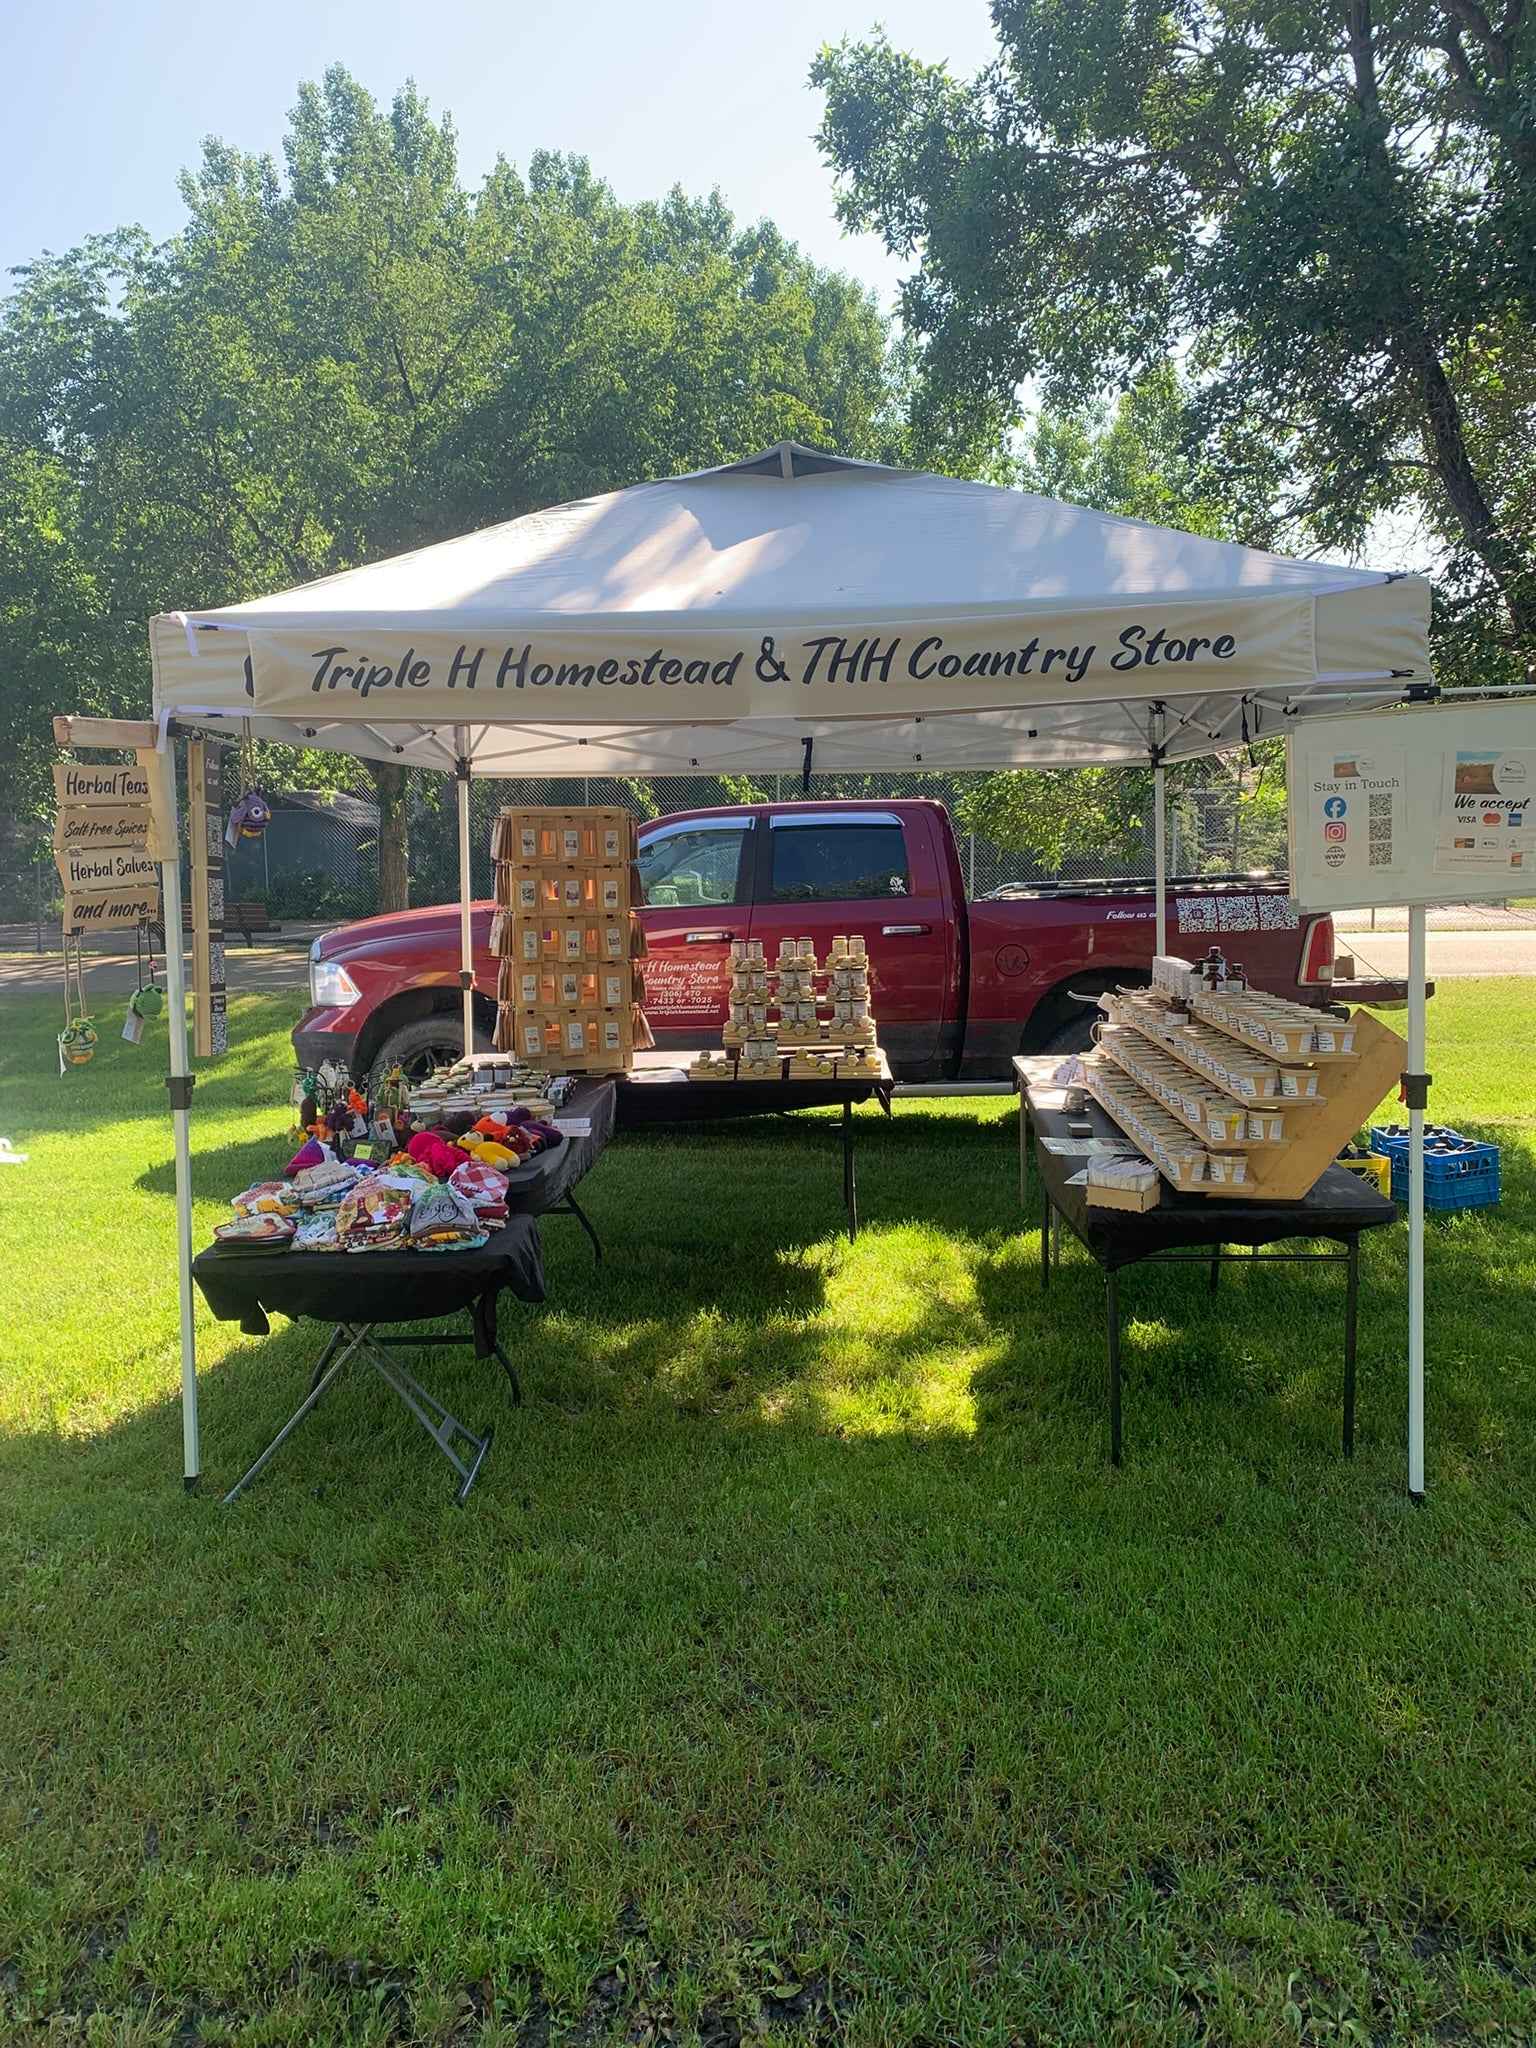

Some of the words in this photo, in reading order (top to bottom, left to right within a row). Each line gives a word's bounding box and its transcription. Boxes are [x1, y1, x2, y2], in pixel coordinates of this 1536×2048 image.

[311, 647, 431, 697] Triple
[447, 645, 485, 688] H
[496, 644, 744, 688] Homestead
[755, 636, 791, 682] &
[801, 636, 901, 684] THH
[907, 636, 1096, 683] Country
[1109, 624, 1236, 671] Store
[66, 771, 117, 796] Herbal
[119, 771, 149, 796] Teas
[1313, 782, 1341, 793] Stay
[1345, 780, 1357, 790] in
[1360, 777, 1400, 789] Touch
[1454, 794, 1476, 809] We
[1479, 797, 1531, 812] accept
[114, 819, 148, 838] Spices
[1457, 815, 1478, 824] VISA
[70, 861, 113, 881] Herbal
[116, 857, 154, 877] Salves
[73, 899, 106, 920] and
[108, 903, 157, 919] more...
[1106, 910, 1135, 920] Follow
[647, 960, 658, 972] H
[659, 960, 721, 972] Homestead
[643, 974, 685, 985] Country
[688, 973, 719, 985] Store
